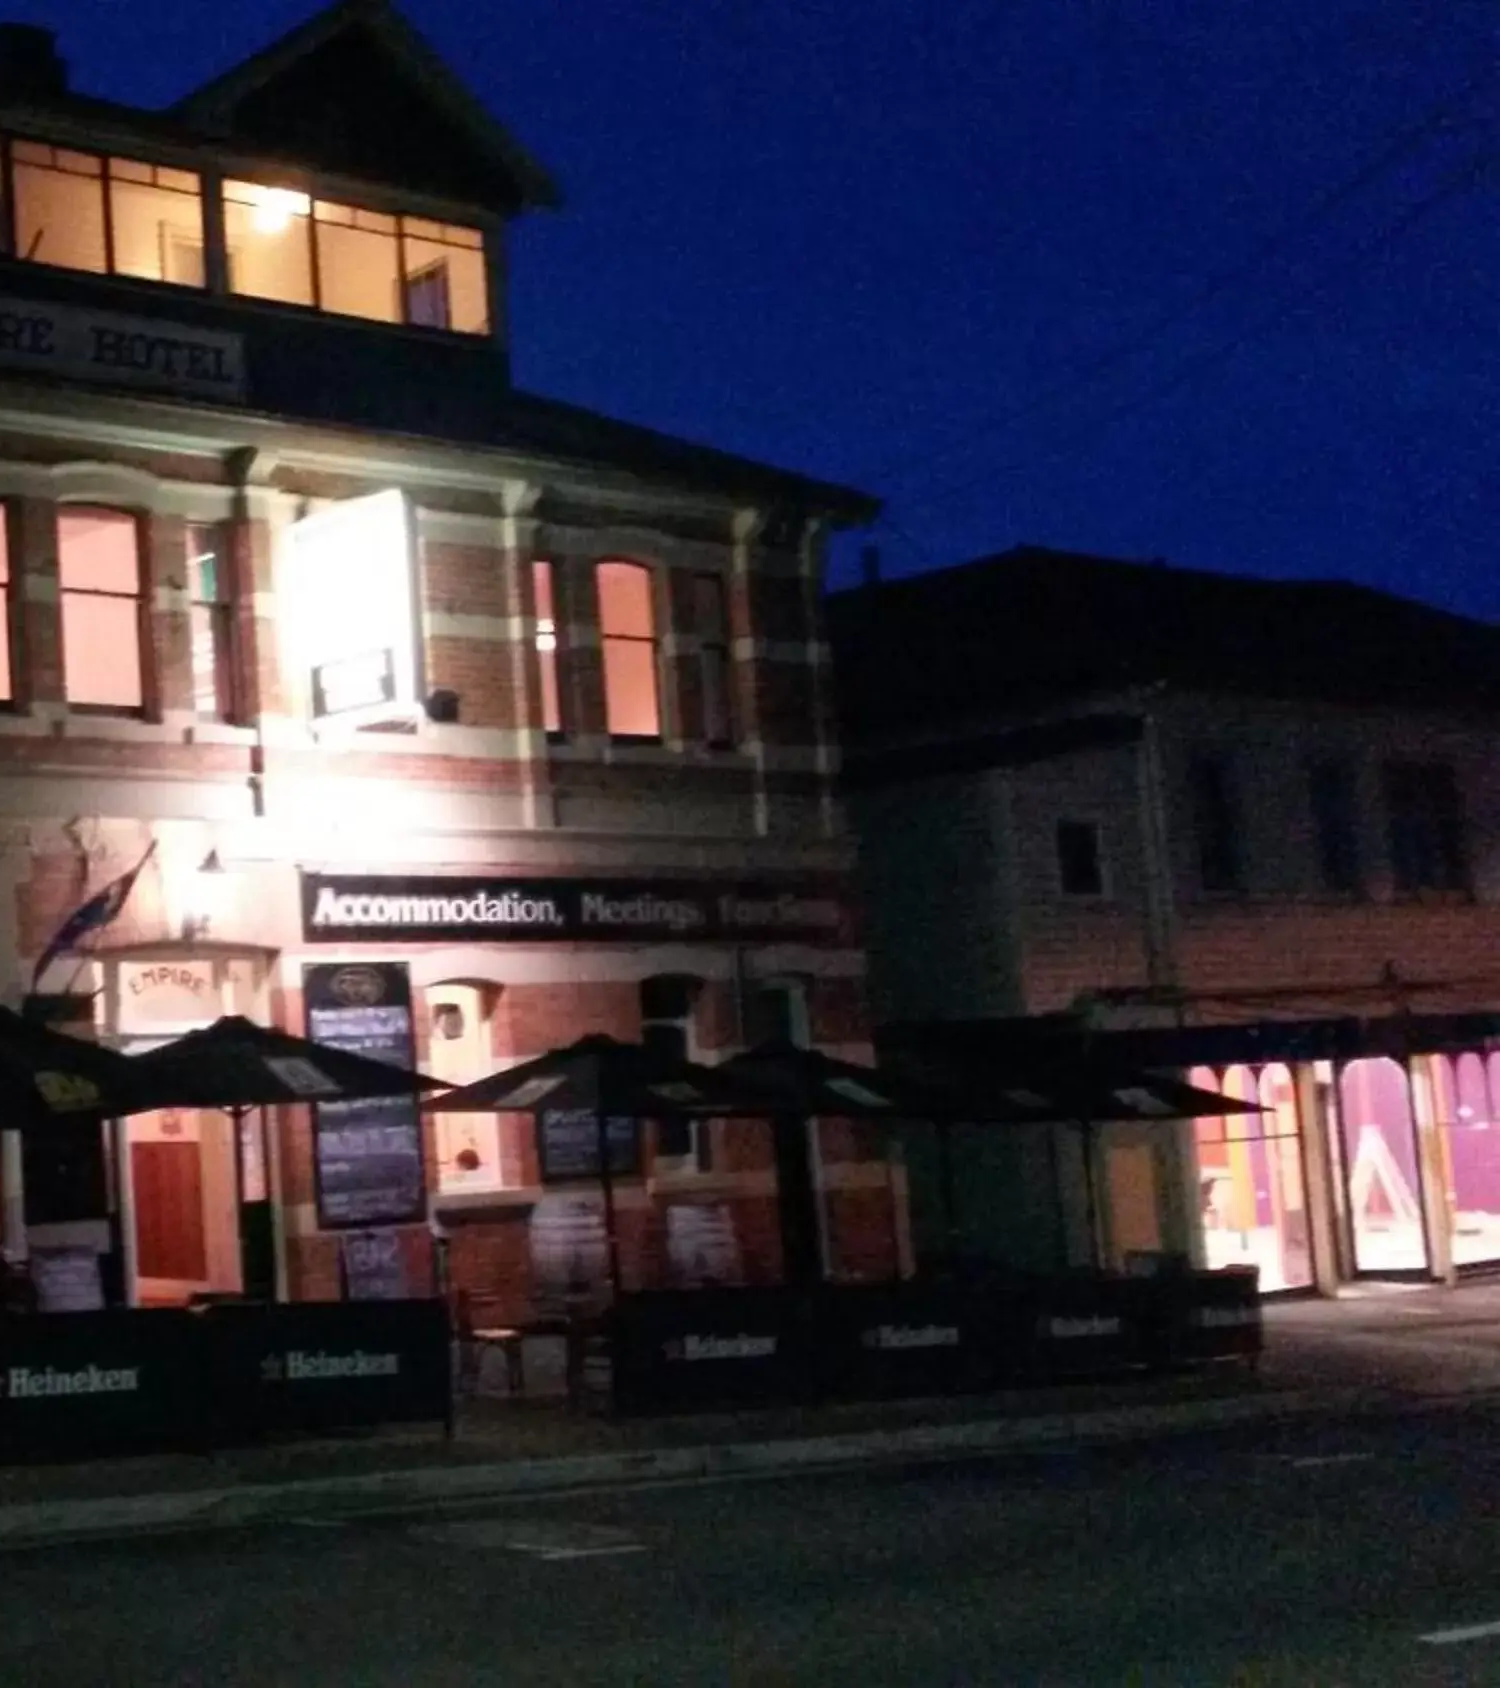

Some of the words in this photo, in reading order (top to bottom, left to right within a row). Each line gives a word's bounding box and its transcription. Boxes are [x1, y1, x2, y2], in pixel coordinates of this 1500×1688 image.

[90, 325, 233, 382] HOTEL
[313, 886, 564, 928] Accommodation,
[128, 966, 206, 996] EMPIRE
[7, 1364, 141, 1399] Heineken
[284, 1350, 400, 1379] Heineken
